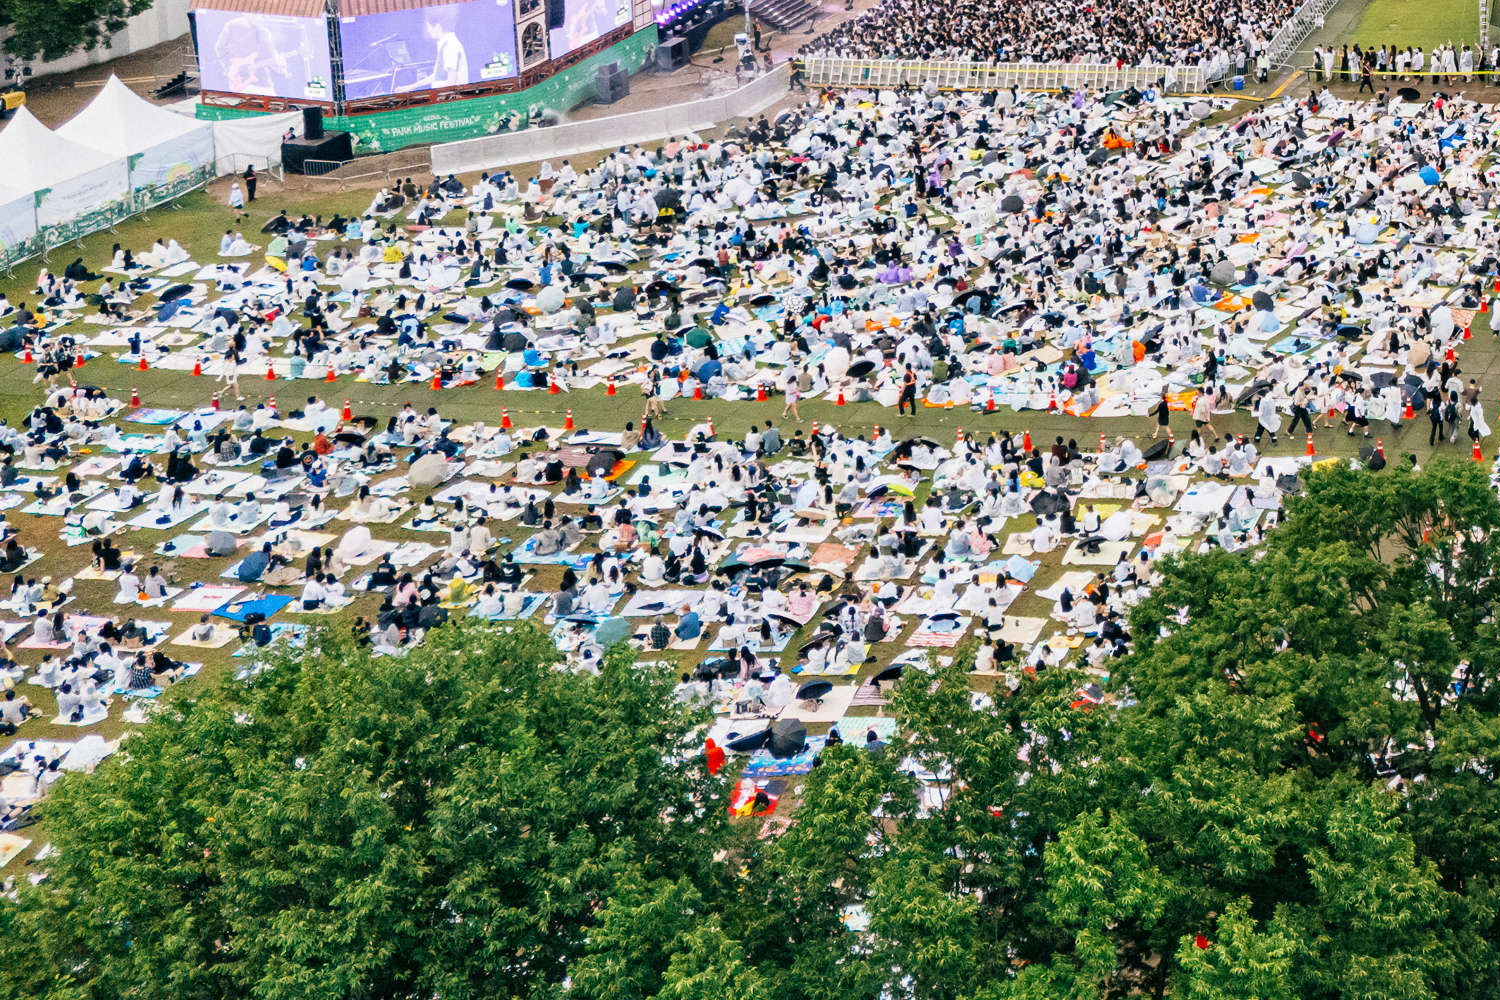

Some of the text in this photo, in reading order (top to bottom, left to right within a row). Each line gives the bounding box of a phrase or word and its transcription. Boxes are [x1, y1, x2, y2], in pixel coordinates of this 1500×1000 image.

[391, 116, 475, 137] PARK MUSIC FESTIVAL
